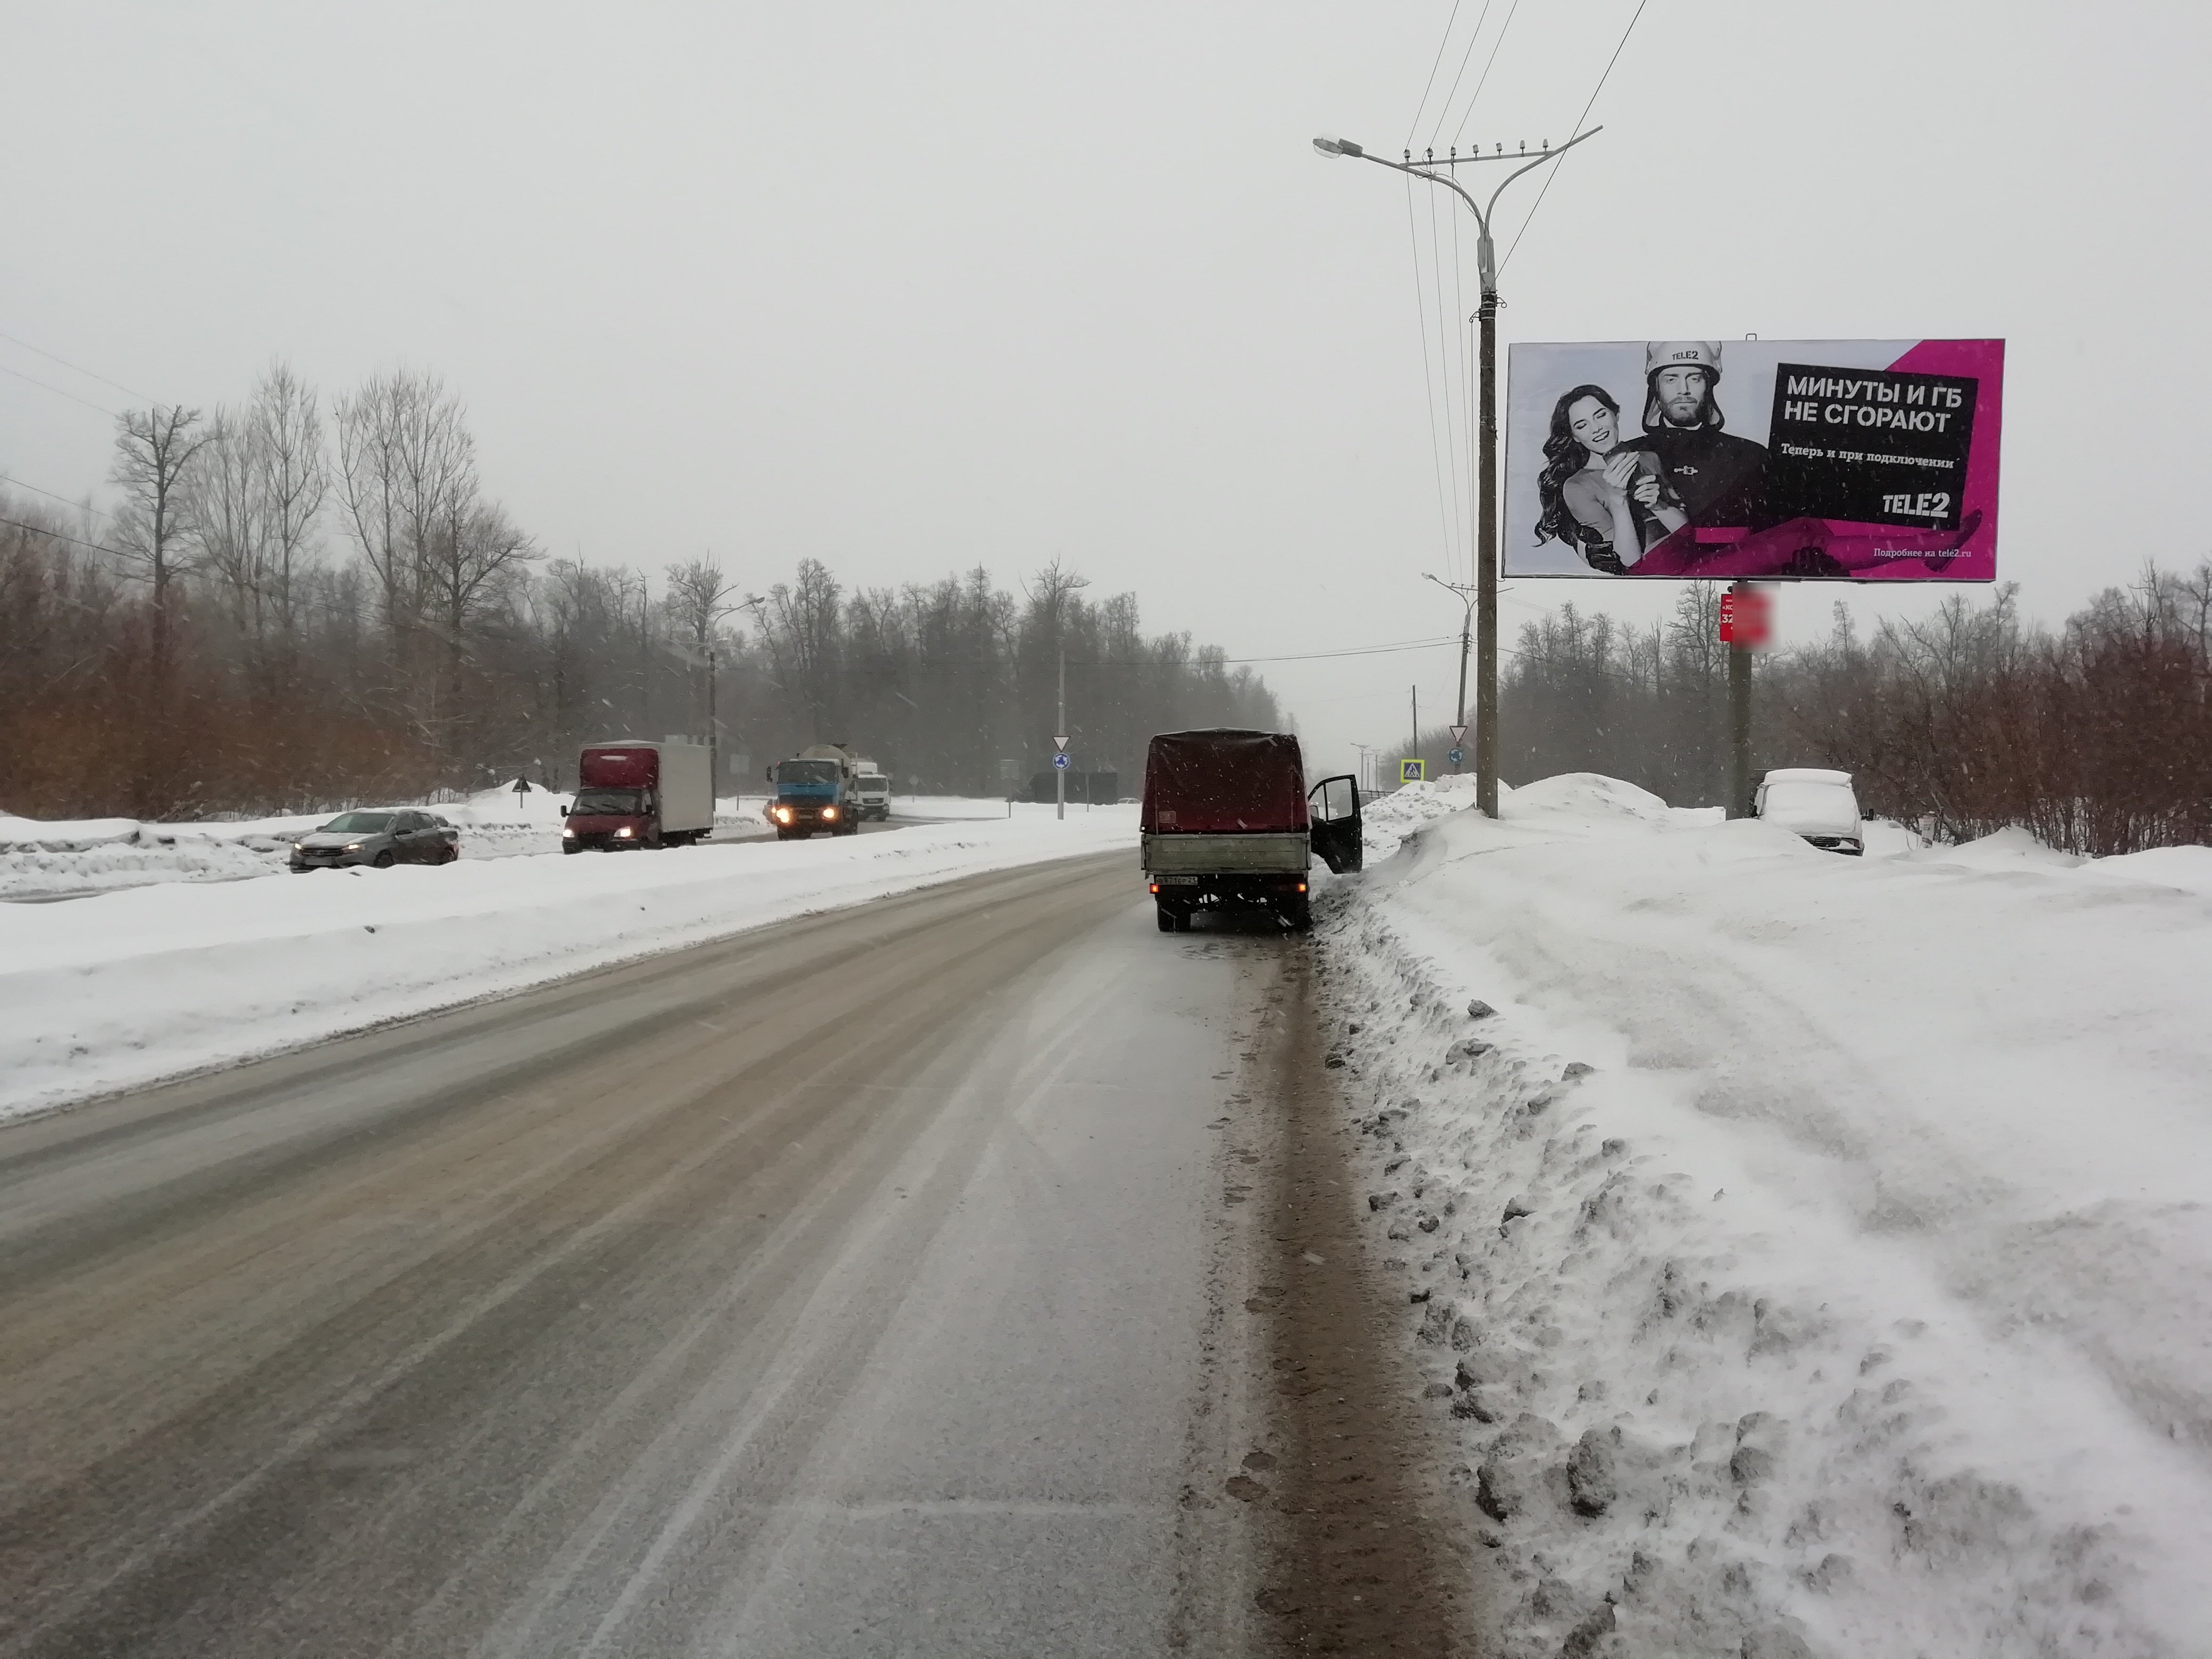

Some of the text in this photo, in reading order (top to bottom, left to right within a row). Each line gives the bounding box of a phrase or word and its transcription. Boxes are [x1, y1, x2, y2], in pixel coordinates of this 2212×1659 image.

[1672, 350, 1698, 360] TELE2
[1787, 375, 1962, 408] МИНУТЫ И ГБ
[1784, 400, 1951, 433] НЕ СГОРАЮТ
[1781, 443, 1824, 458] Теперь
[1839, 450, 1864, 462] при
[1866, 453, 1954, 468] подключении
[1883, 492, 1950, 518] TELE2
[1873, 548, 1922, 558] Подробнее
[1938, 548, 1972, 558] tele2.ru
